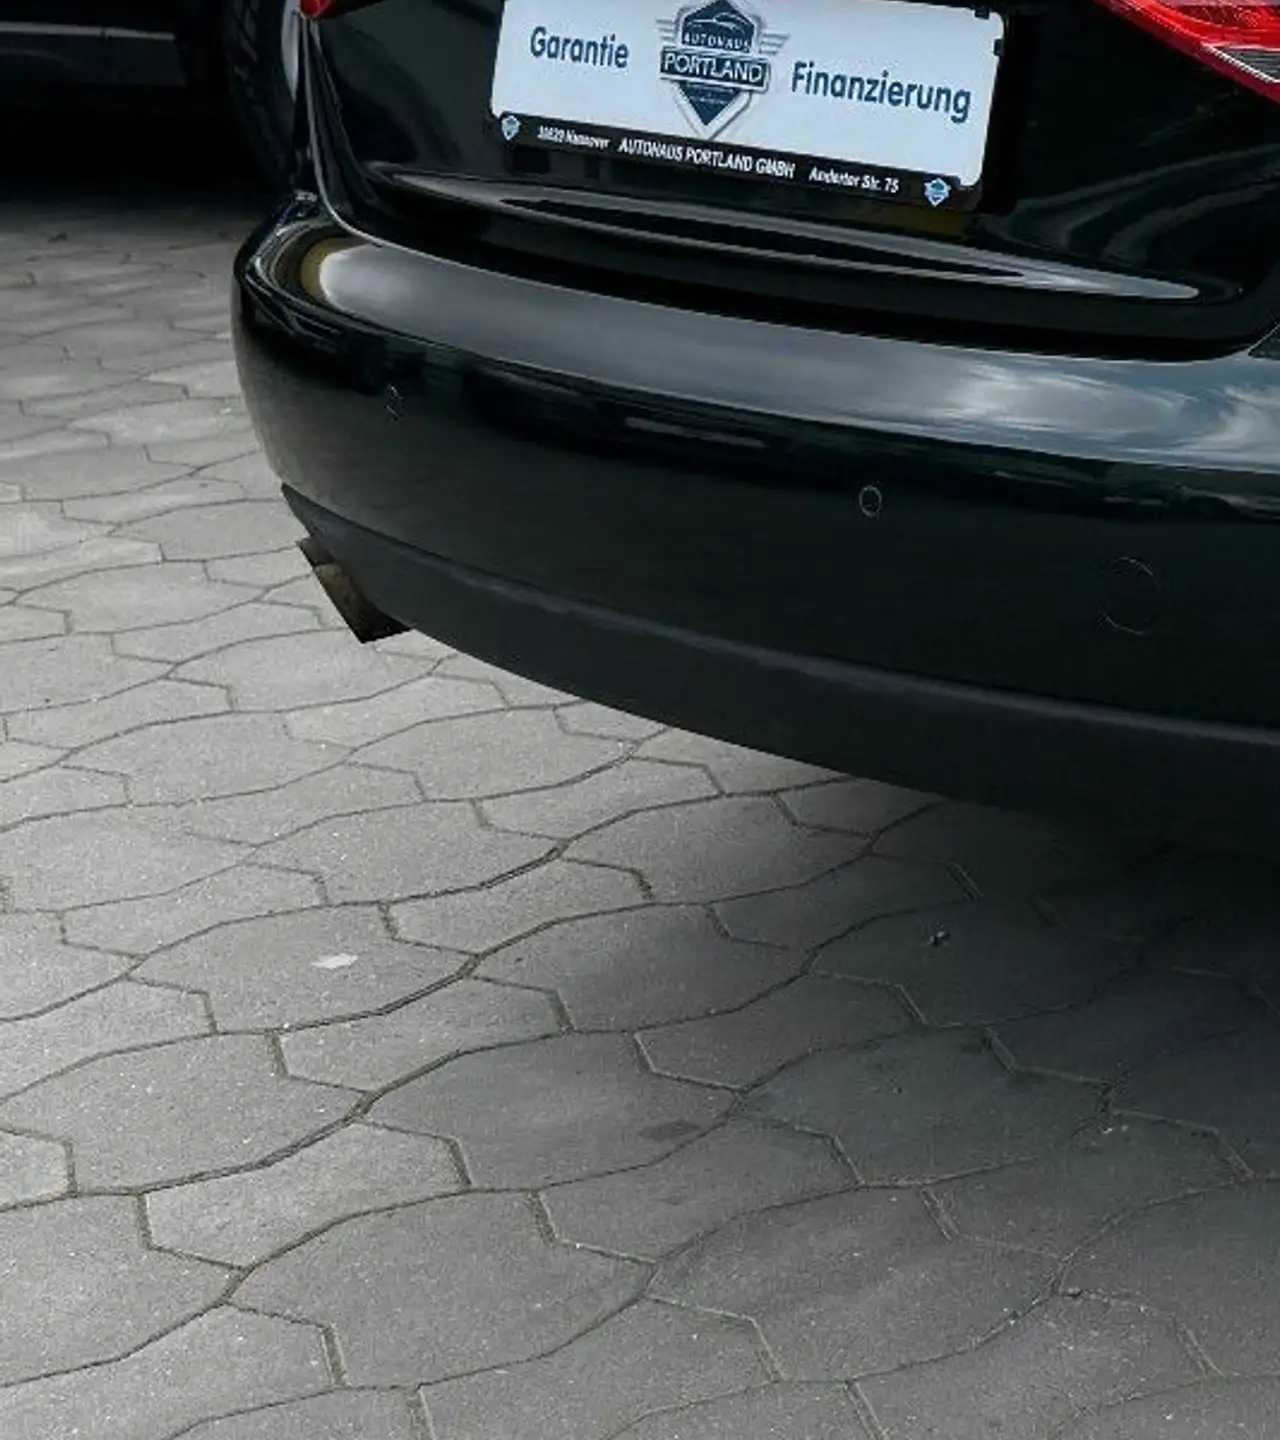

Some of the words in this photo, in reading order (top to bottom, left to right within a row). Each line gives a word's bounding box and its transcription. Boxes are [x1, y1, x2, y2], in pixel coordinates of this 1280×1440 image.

[530, 25, 630, 69] Garantie
[683, 32, 751, 52] AUTOHAUS
[663, 52, 763, 83] PORTLAND
[791, 60, 972, 124] Finanzierung
[617, 136, 684, 161] AUTOHAUS
[684, 147, 753, 172] PORTLAND
[883, 177, 900, 194] 75
